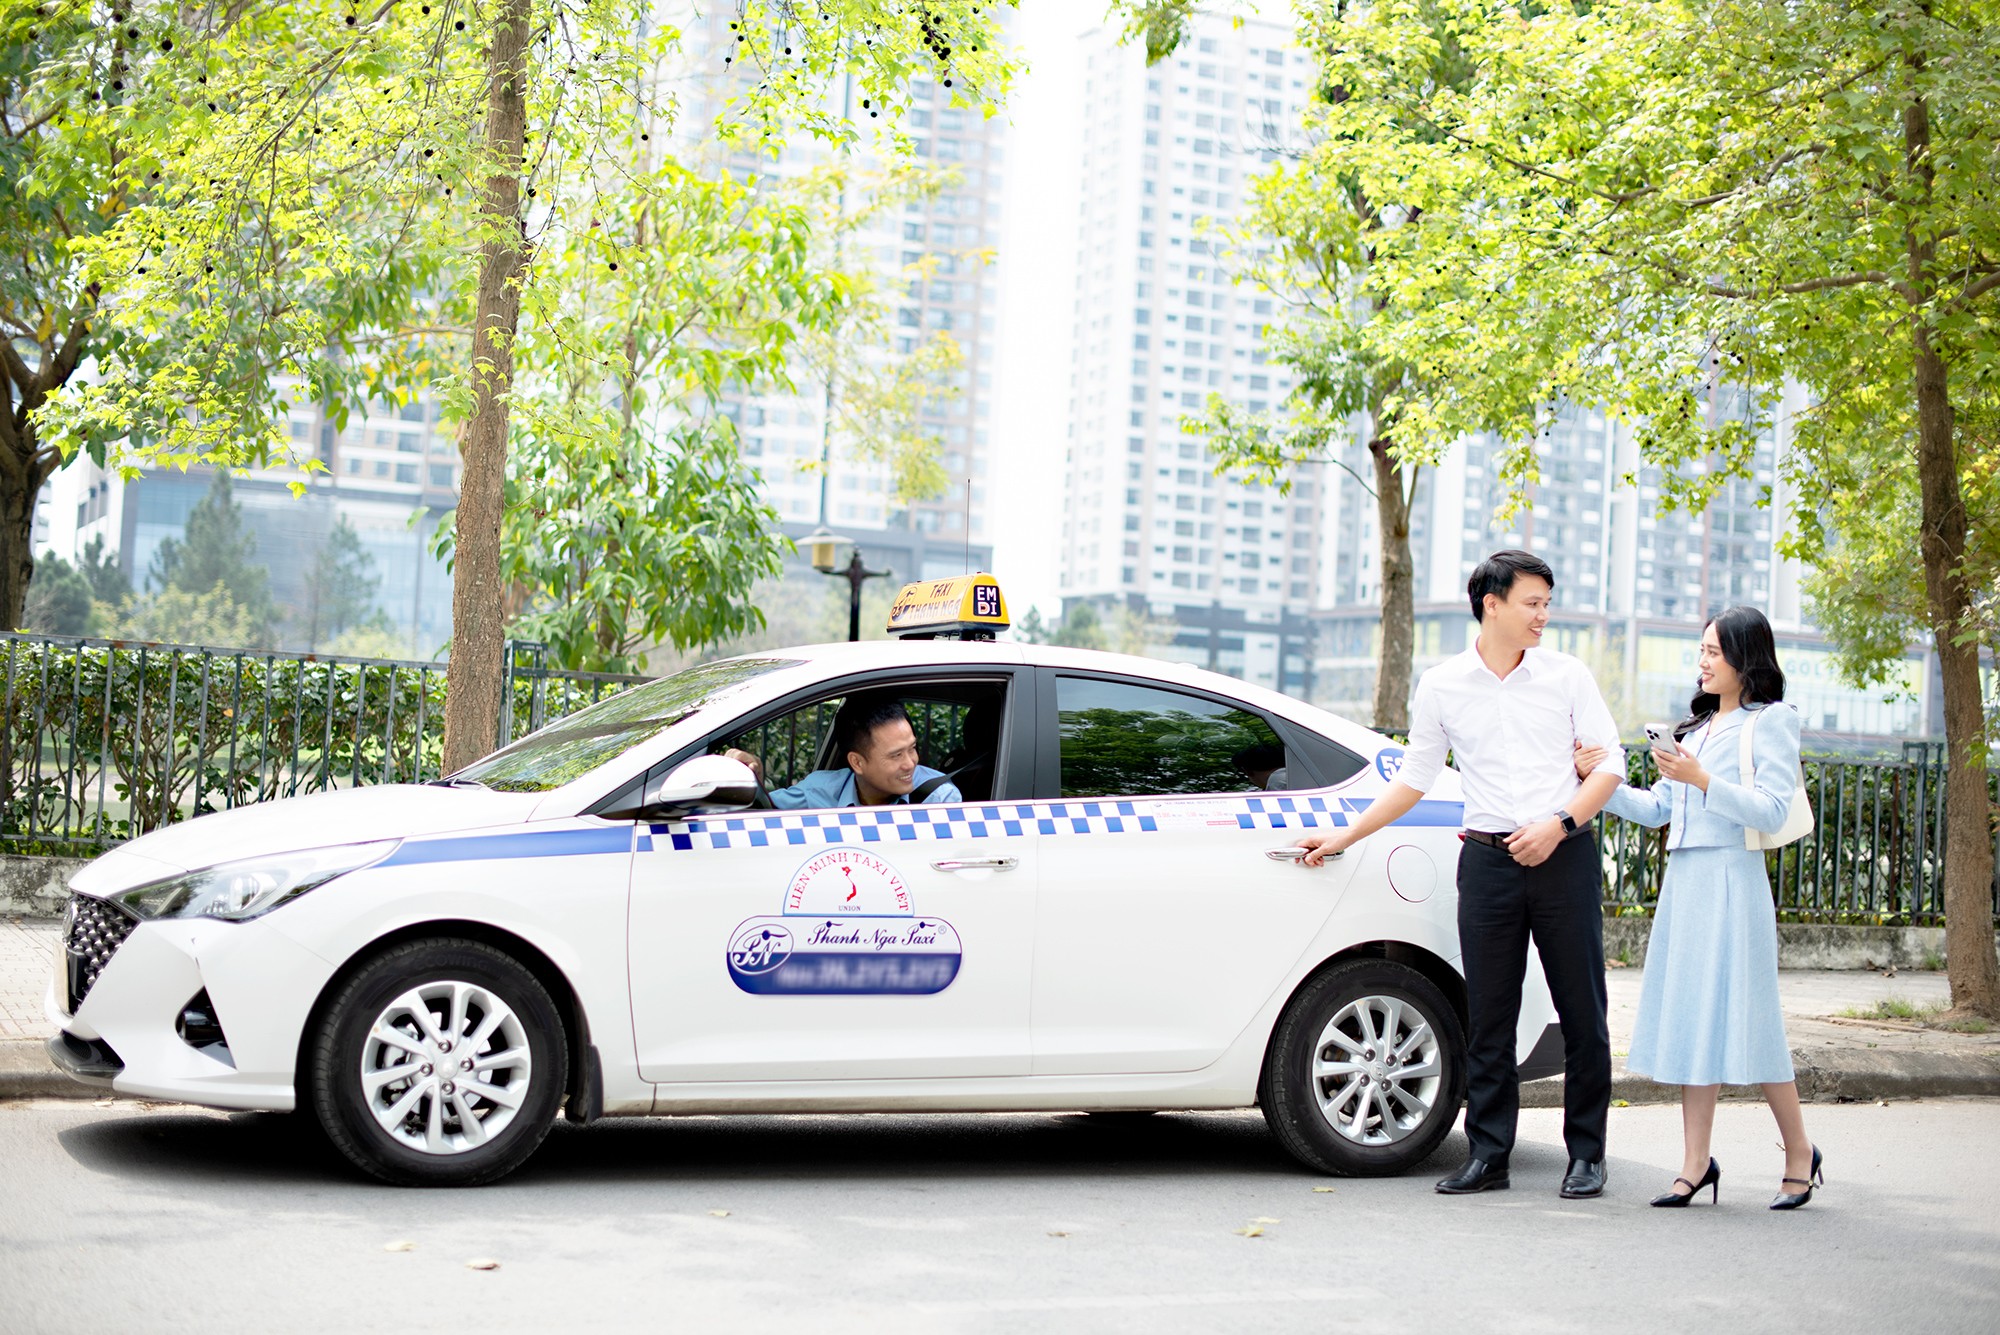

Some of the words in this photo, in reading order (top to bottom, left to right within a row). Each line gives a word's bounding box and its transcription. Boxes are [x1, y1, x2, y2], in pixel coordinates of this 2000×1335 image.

[930, 582, 954, 598] TAXI
[977, 586, 997, 601] EM
[977, 601, 997, 615] DI
[809, 852, 848, 875] MINH
[853, 852, 889, 876] TAXI
[808, 920, 860, 945] Thanh
[863, 928, 898, 951] Nga
